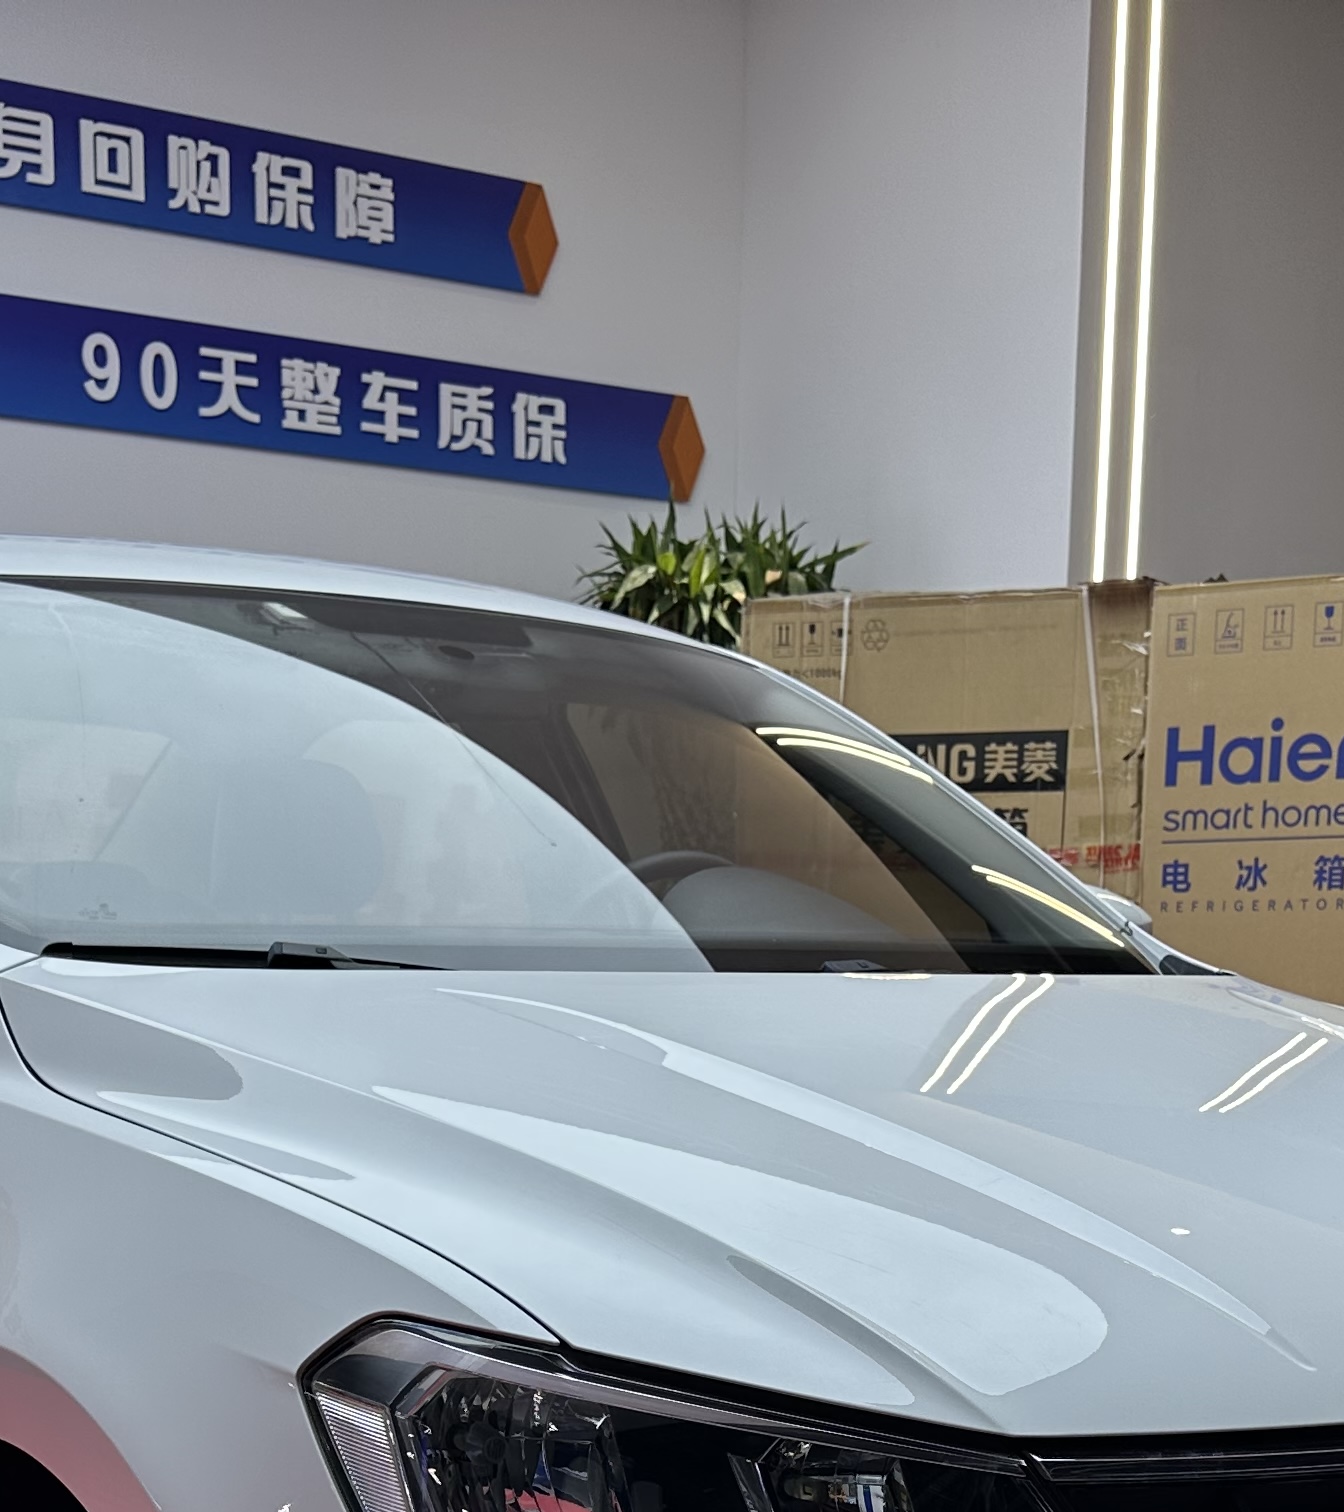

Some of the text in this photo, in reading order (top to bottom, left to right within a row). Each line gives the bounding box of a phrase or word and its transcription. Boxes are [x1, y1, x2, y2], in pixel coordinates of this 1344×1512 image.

[81, 332, 568, 467] 90天整车质保
[983, 740, 1059, 784] 美菱
[1163, 802, 1254, 832] smart
[1160, 898, 1344, 913] REFRIGERATOR
